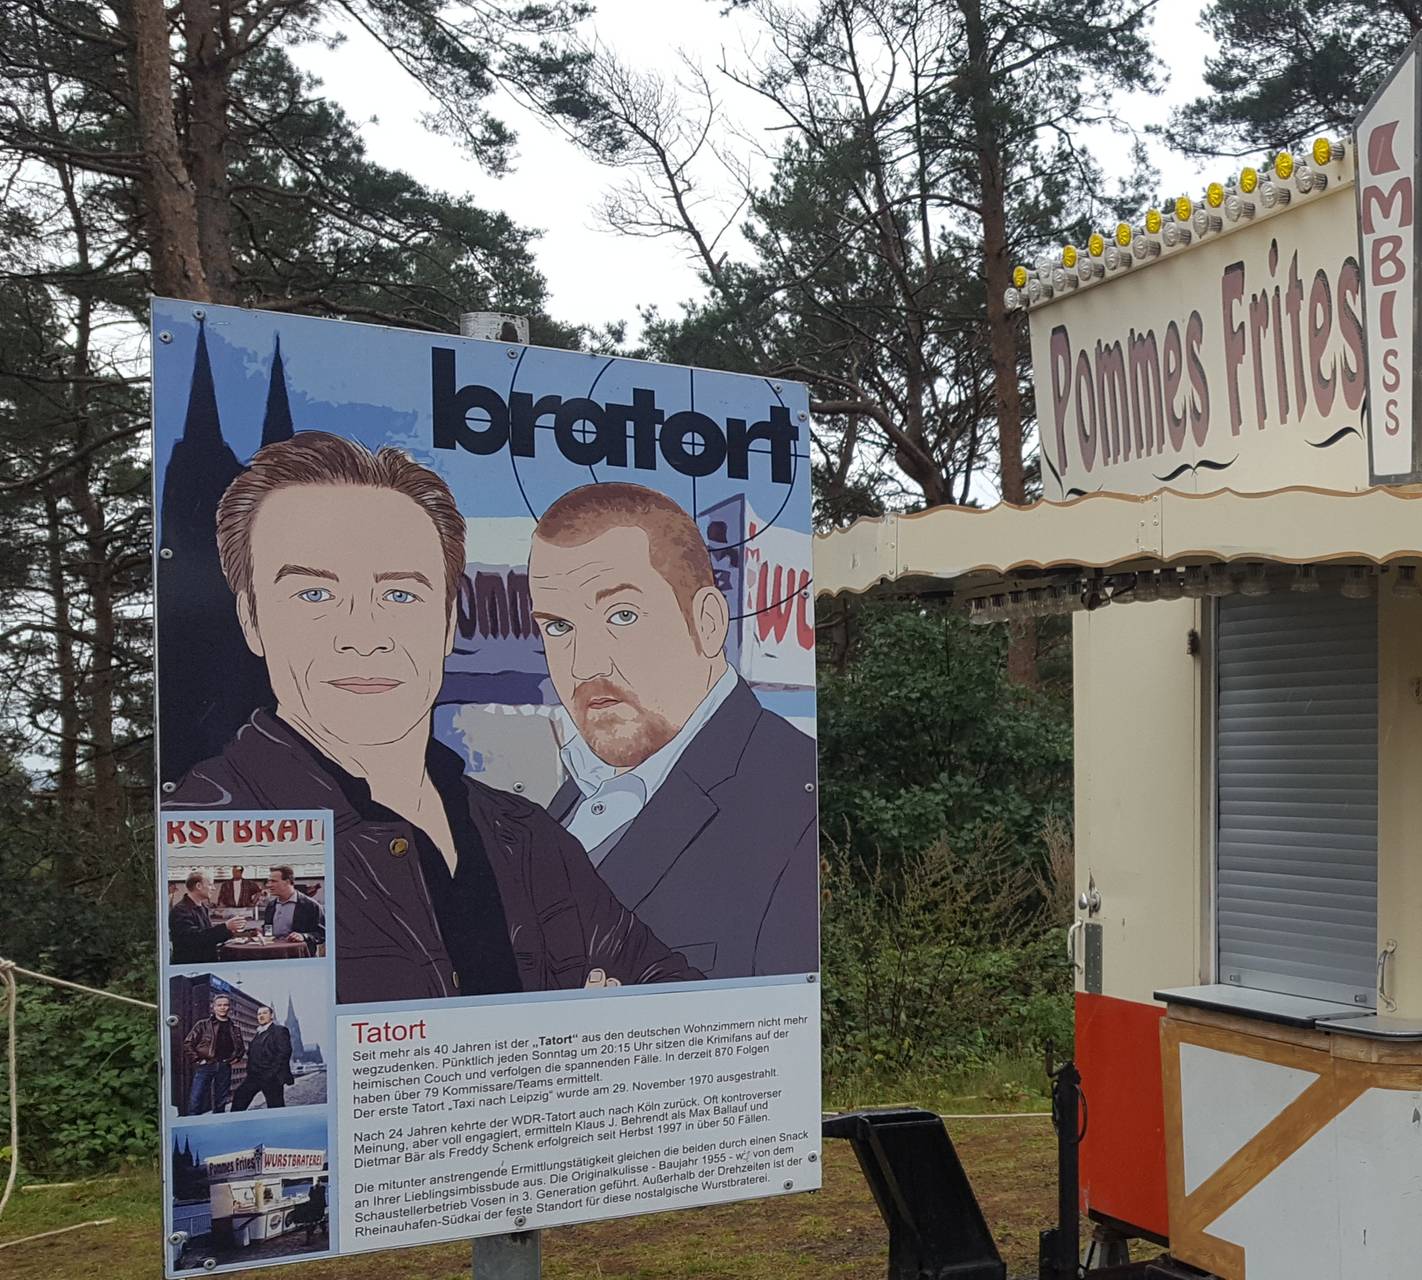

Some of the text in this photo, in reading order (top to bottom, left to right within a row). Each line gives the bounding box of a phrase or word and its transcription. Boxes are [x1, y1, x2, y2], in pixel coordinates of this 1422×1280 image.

[1363, 120, 1412, 436] IMBISS
[1050, 239, 1366, 476] Pommes Frites
[431, 346, 799, 484] bratort
[351, 1019, 427, 1044] Tatort
[352, 1049, 376, 1062] Seit
[379, 1046, 412, 1060] mehr
[413, 1044, 431, 1057] als
[433, 1042, 449, 1055] 40
[450, 1040, 492, 1054] Jahren
[494, 1038, 508, 1050] ist
[510, 1037, 530, 1049] der
[581, 1032, 602, 1043] aus
[604, 1029, 624, 1041] den
[626, 1024, 681, 1039] deutschen
[683, 1019, 755, 1034] Wohnzimmern
[757, 1015, 781, 1028] nicht
[783, 1012, 808, 1025] mehr
[442, 1052, 494, 1068] Pünktlich
[497, 1050, 529, 1066] jeden
[532, 1047, 578, 1060] Sonntag
[580, 1046, 598, 1056] um
[599, 1040, 631, 1054] 20:15
[632, 1039, 654, 1052] Uhr
[654, 1037, 686, 1050] sitzen
[687, 1034, 704, 1047] die
[705, 1031, 754, 1045] Krimifans
[754, 1028, 771, 1041] auf
[772, 1027, 790, 1039] der
[352, 1074, 422, 1091] heimischen
[424, 1069, 462, 1084] Couch
[465, 1067, 487, 1080] und
[489, 1063, 542, 1078] verfolgen
[544, 1060, 562, 1073] die
[564, 1055, 631, 1073] spannenden
[665, 1050, 676, 1062] In
[677, 1047, 712, 1061] derzeit
[714, 1044, 734, 1057] 870
[736, 1042, 770, 1057] Folgen
[353, 1091, 391, 1105] haben
[394, 1088, 422, 1101] über
[423, 1085, 440, 1098] 79
[442, 1077, 553, 1096] Kommissare/Teams
[353, 1108, 377, 1120] Der
[378, 1105, 409, 1117] erste
[411, 1100, 446, 1114] Tatort
[478, 1093, 506, 1107] nach
[556, 1085, 590, 1099] wurde
[592, 1085, 610, 1096] am
[631, 1076, 686, 1092] November
[688, 1072, 714, 1086] 1970
[353, 1128, 385, 1143] Nach
[388, 1126, 404, 1139] 24
[406, 1124, 448, 1137] Jahren
[449, 1119, 487, 1133] kehrte
[488, 1116, 509, 1129] der
[510, 1109, 577, 1126] WDR-Tatort
[578, 1104, 607, 1119] auch
[608, 1101, 634, 1116] nach
[636, 1099, 661, 1113] Köln
[703, 1093, 719, 1105] Oft
[720, 1089, 782, 1104] kontroverser
[354, 1155, 402, 1169] Dietmar
[404, 1150, 426, 1163] Bär
[428, 1148, 446, 1161] als
[448, 1143, 490, 1158] Freddy
[492, 1137, 535, 1153] Schenk
[536, 1130, 594, 1148] erfolgreich
[595, 1128, 616, 1141] seit
[619, 1124, 654, 1139] Herbst
[656, 1120, 682, 1134] 1997
[684, 1119, 694, 1131] in
[696, 1117, 721, 1130] über
[721, 1114, 738, 1127] 50
[412, 1136, 440, 1149] aber
[441, 1132, 463, 1146] voll
[524, 1120, 573, 1137] ermitteln
[575, 1118, 606, 1131] Klaus
[620, 1110, 669, 1126] Behrendt
[670, 1108, 686, 1120] als
[688, 1106, 711, 1118] Max
[713, 1100, 748, 1116] Ballauf
[749, 1098, 769, 1112] und
[354, 1127, 809, 1194] Die mitunter anstrengende Ermittlungstätigkeit gleichen die beiden durch einen Snack
[354, 1199, 370, 1209] an
[373, 1194, 403, 1206] Ihrer
[404, 1177, 520, 1203] Lieblingsimbissbude
[549, 1171, 569, 1184] Die
[571, 1162, 649, 1182] Originalkulisse
[658, 1155, 699, 1171] Baujahr
[702, 1150, 726, 1165] 1955
[752, 1148, 770, 1158] von
[772, 1144, 794, 1156] dem
[354, 1197, 468, 1224] Schaustellerbetrieb
[470, 1195, 506, 1208] Vosen
[509, 1191, 519, 1203] in
[536, 1182, 597, 1200] Generation
[641, 1167, 696, 1186] Außerhalb
[697, 1166, 715, 1178] der
[717, 1160, 771, 1176] Drehzeiten
[772, 1157, 785, 1169] ist
[785, 1155, 803, 1167] der
[354, 1209, 481, 1238] Rheinauhafen-Südkai
[483, 1208, 503, 1220] der
[505, 1204, 533, 1218] feste
[536, 1197, 584, 1213] Standort
[585, 1194, 601, 1207] für
[602, 1192, 632, 1204] diese
[633, 1181, 699, 1200] nostalgische
